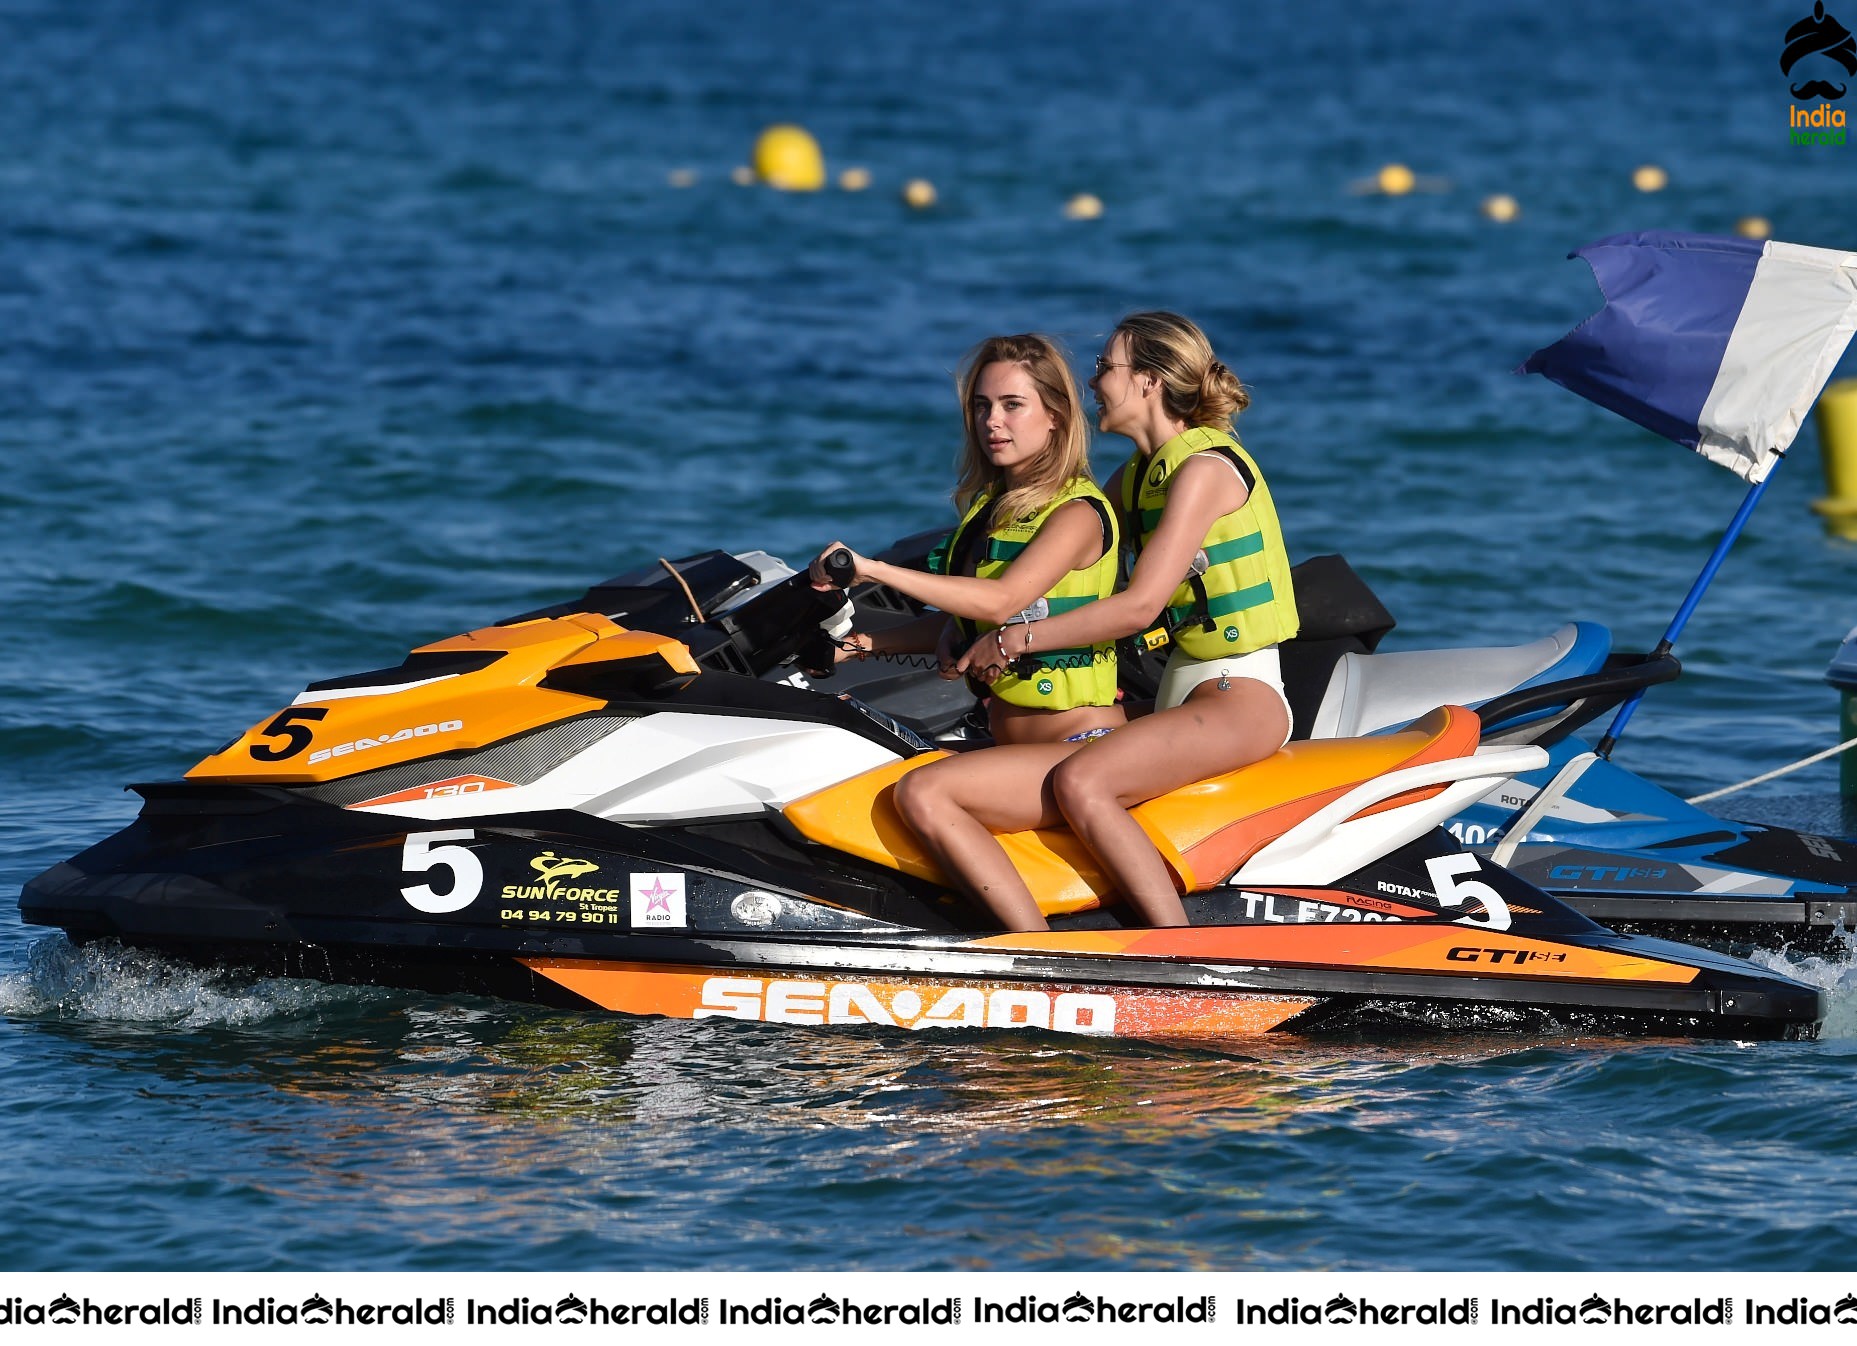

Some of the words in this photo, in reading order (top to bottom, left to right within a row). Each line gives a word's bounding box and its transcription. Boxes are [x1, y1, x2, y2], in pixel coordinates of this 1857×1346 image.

[1226, 629, 1238, 638] XS
[1039, 683, 1052, 692] XS
[249, 707, 329, 762] 5
[424, 781, 485, 799] 130
[1500, 794, 1533, 808] ROTA
[400, 828, 483, 914] 5
[1377, 881, 1421, 899] ROTAX
[1425, 852, 1512, 931] 5
[579, 903, 589, 911] St
[590, 904, 619, 912] Tropez
[1240, 891, 1285, 923] TL
[501, 910, 523, 920] 04
[528, 911, 551, 921] 94
[556, 912, 577, 922] 79
[582, 913, 604, 923] 90
[608, 914, 618, 924] 11
[1446, 947, 1529, 965] GTI
